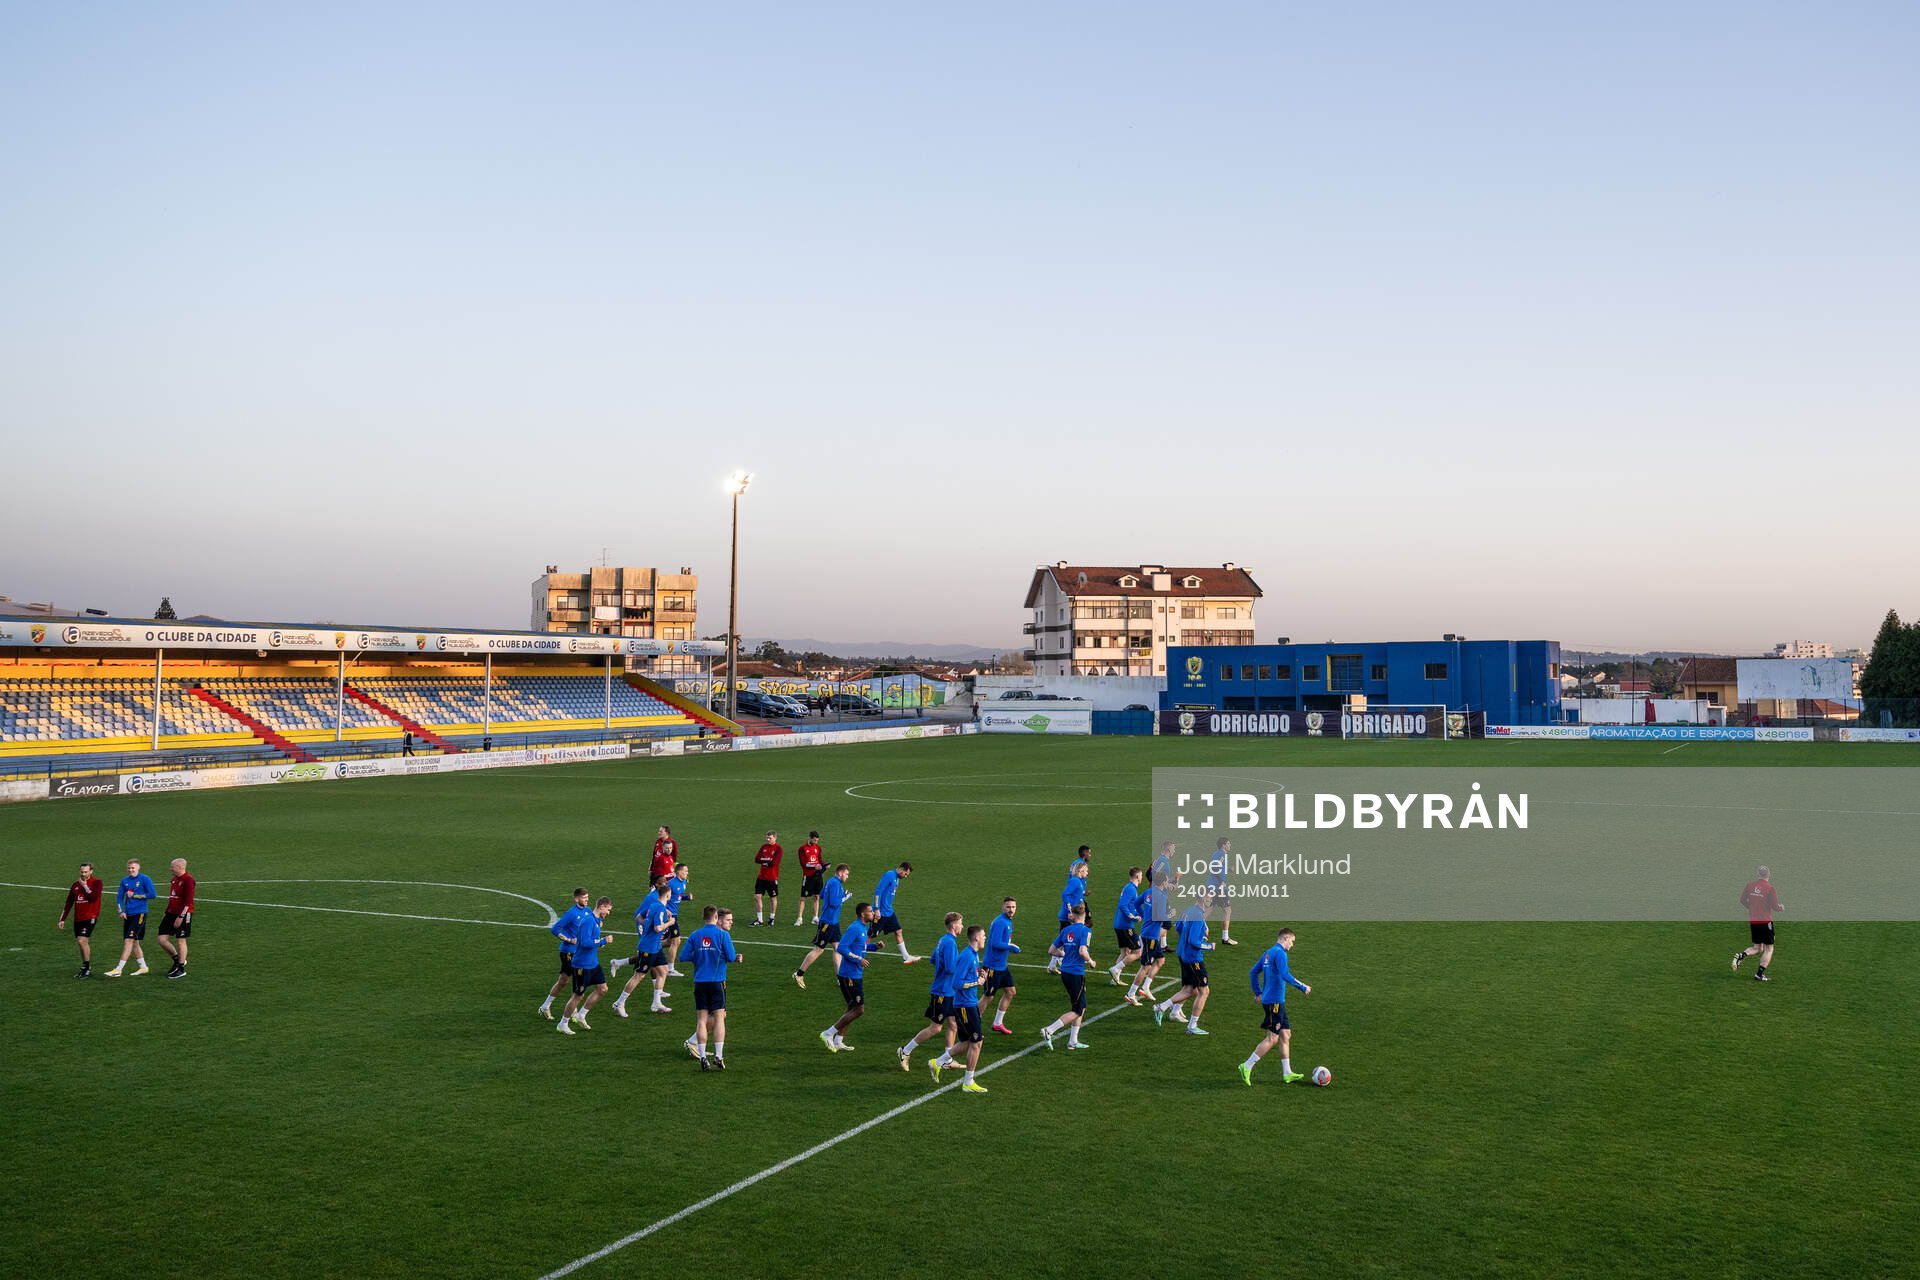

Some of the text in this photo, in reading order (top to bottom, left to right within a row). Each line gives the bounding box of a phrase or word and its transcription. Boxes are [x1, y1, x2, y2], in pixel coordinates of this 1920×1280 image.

[145, 631, 257, 643] O CLUBE DA CIDADE
[488, 640, 561, 649] O CLUBE DA CIDADE
[1210, 713, 1290, 733] OBRIGADO
[1341, 714, 1426, 734] OBRIGADO
[1485, 726, 1511, 735] BigMat
[1548, 728, 1588, 736] 4sense
[1590, 726, 1754, 740] AROMATIZAÇÃO DE ESPAÇOS
[1765, 730, 1809, 739] 4sense
[270, 767, 329, 779] UVPLAST
[64, 783, 115, 796] PLAYOFF
